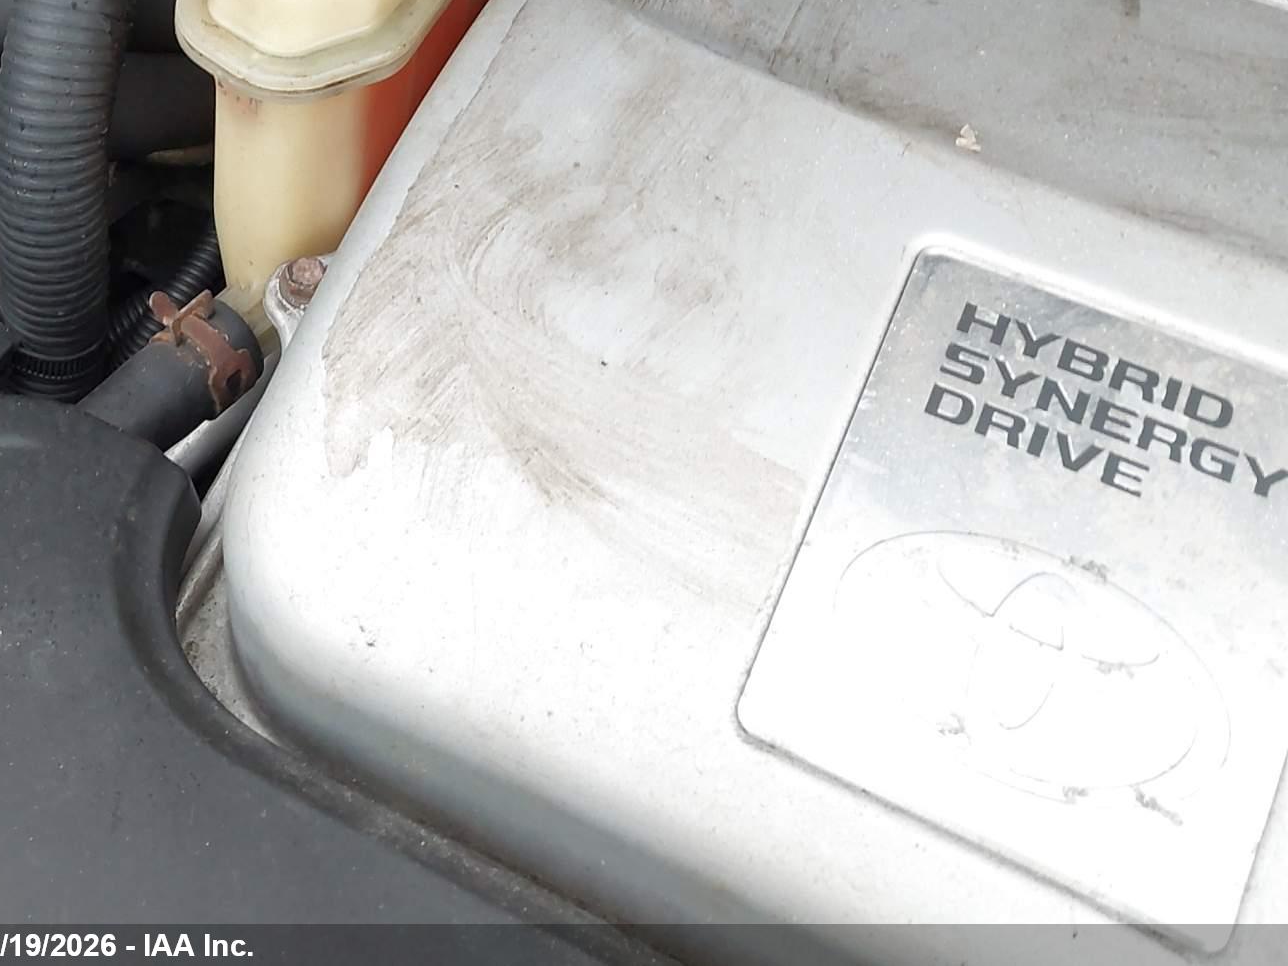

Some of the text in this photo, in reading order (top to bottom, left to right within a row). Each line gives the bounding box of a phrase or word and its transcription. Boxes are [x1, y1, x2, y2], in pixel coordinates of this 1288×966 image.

[939, 342, 1288, 498] SYNERGY
[956, 302, 1235, 429] HYBRID
[924, 383, 1150, 498] DRIVE
